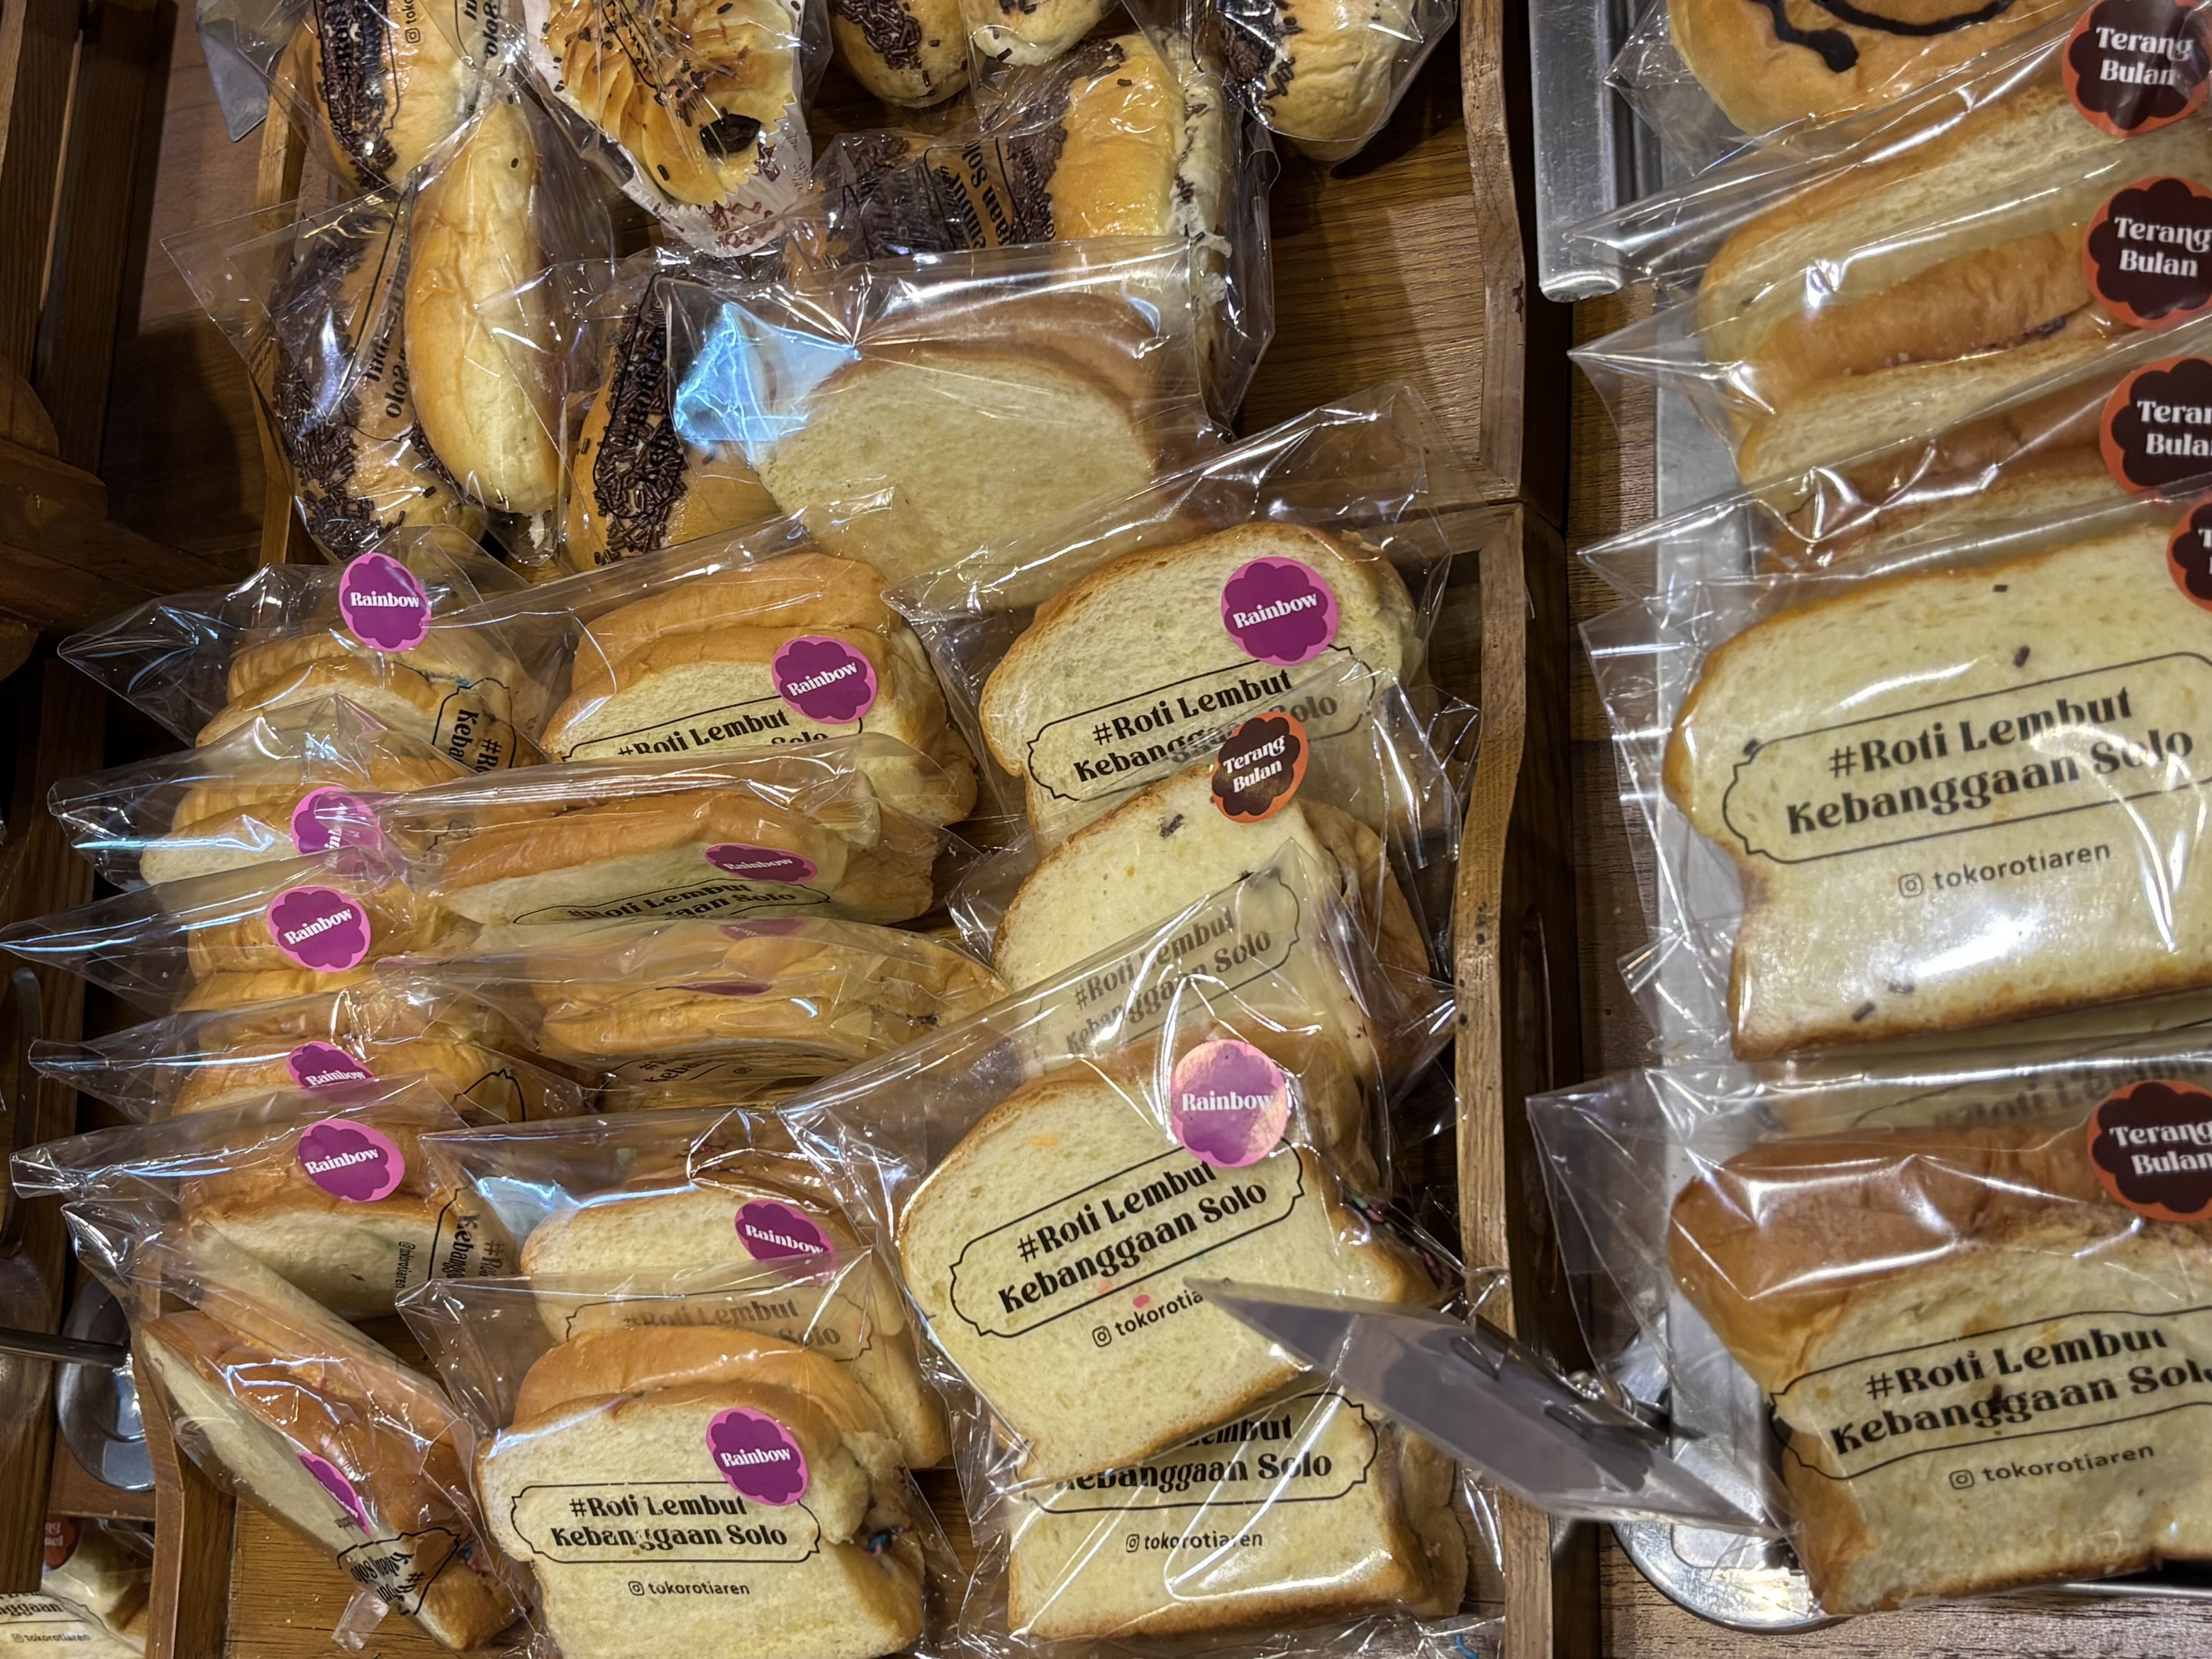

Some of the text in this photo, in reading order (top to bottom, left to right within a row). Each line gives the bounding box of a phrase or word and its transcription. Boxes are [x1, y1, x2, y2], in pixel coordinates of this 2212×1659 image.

[2096, 27, 2193, 62] Terang
[2099, 59, 2176, 86] Bulan
[2114, 217, 2212, 253] Terang
[2119, 249, 2198, 278] Bulan
[2145, 433, 2212, 456] Bula
[351, 591, 420, 608] Rainbow
[1233, 593, 1317, 629] Rainbow
[787, 662, 857, 696] Rainbow
[1092, 669, 1294, 746] #Roti Lembut
[689, 709, 790, 746] Lembut
[1828, 686, 2133, 779] #Roti Lembut
[1224, 735, 1285, 774] Terang
[1233, 760, 1283, 793] Bulan
[1786, 728, 2194, 836] Kebanggaan Solo
[1931, 843, 2111, 891] tokorotiaren
[644, 884, 752, 909] Lembut
[284, 909, 353, 945] Rainbow
[1214, 930, 1271, 973] Solo
[305, 1069, 366, 1087] Rainbow
[1182, 1091, 1274, 1111] Rainbow
[2109, 1121, 2212, 1147] Terang
[305, 1147, 379, 1174] Rainbow
[1017, 1161, 1217, 1263] #Roti Lembut
[746, 1224, 824, 1255] Rainbow
[997, 1183, 1267, 1314] Kebanggaan Solo
[1115, 1290, 1204, 1337] tokorotia
[1866, 1328, 2168, 1400] #Roti Lembut
[1830, 1374, 2119, 1455] Kebanggaan
[721, 1447, 791, 1468] Rainbow
[1258, 1451, 1332, 1480] Solo
[1982, 1444, 2154, 1482] tokorotiaren
[569, 1493, 747, 1518] #Roti Lembut
[551, 1524, 787, 1551] Kebanggaan Solo
[648, 1581, 750, 1596] tokorotiaren
